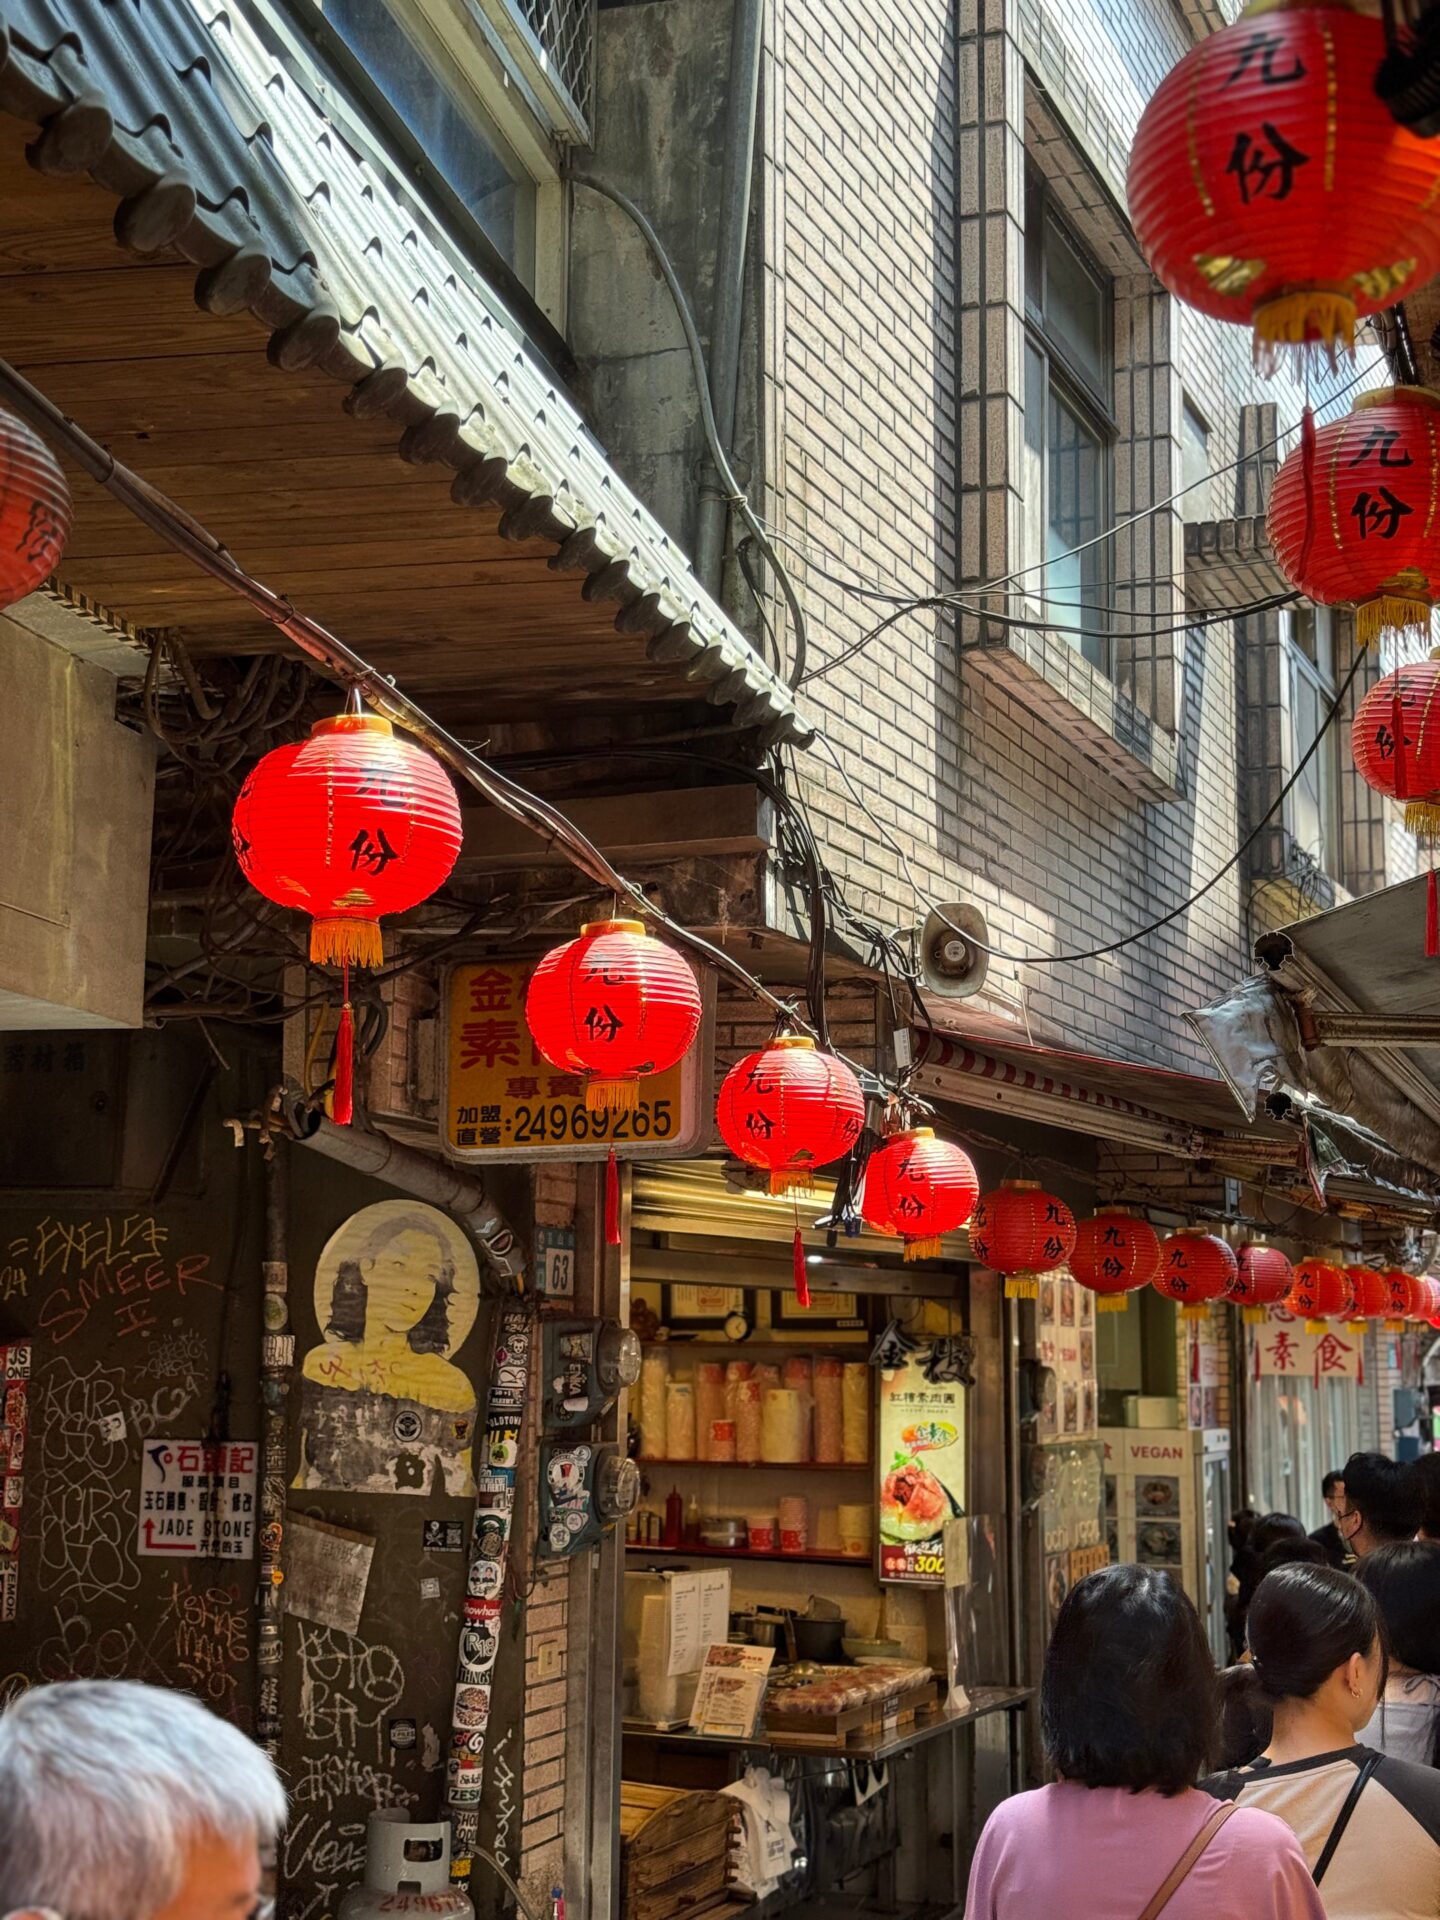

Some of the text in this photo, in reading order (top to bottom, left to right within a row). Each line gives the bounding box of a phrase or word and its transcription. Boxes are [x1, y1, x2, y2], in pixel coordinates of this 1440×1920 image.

[1220, 32, 1310, 204] 九份
[1347, 425, 1415, 540] 九份
[456, 1105, 502, 1125] 加盟
[743, 1066, 776, 1140] 九份
[456, 1126, 502, 1146] 直營
[896, 1158, 927, 1220] 九份
[1042, 1202, 1067, 1260] 九份
[1102, 1225, 1126, 1279] 九份
[1169, 1248, 1189, 1293] 九份
[552, 1254, 569, 1290] 63
[1299, 1271, 1315, 1310] 九份
[1391, 1281, 1406, 1313] 九份
[1265, 1331, 1354, 1372] 素食
[7, 1366, 31, 1379] ONE
[177, 1445, 254, 1474] 石頭記
[1130, 1446, 1183, 1460] VEGAN
[159, 1518, 252, 1538] JADE STONE
